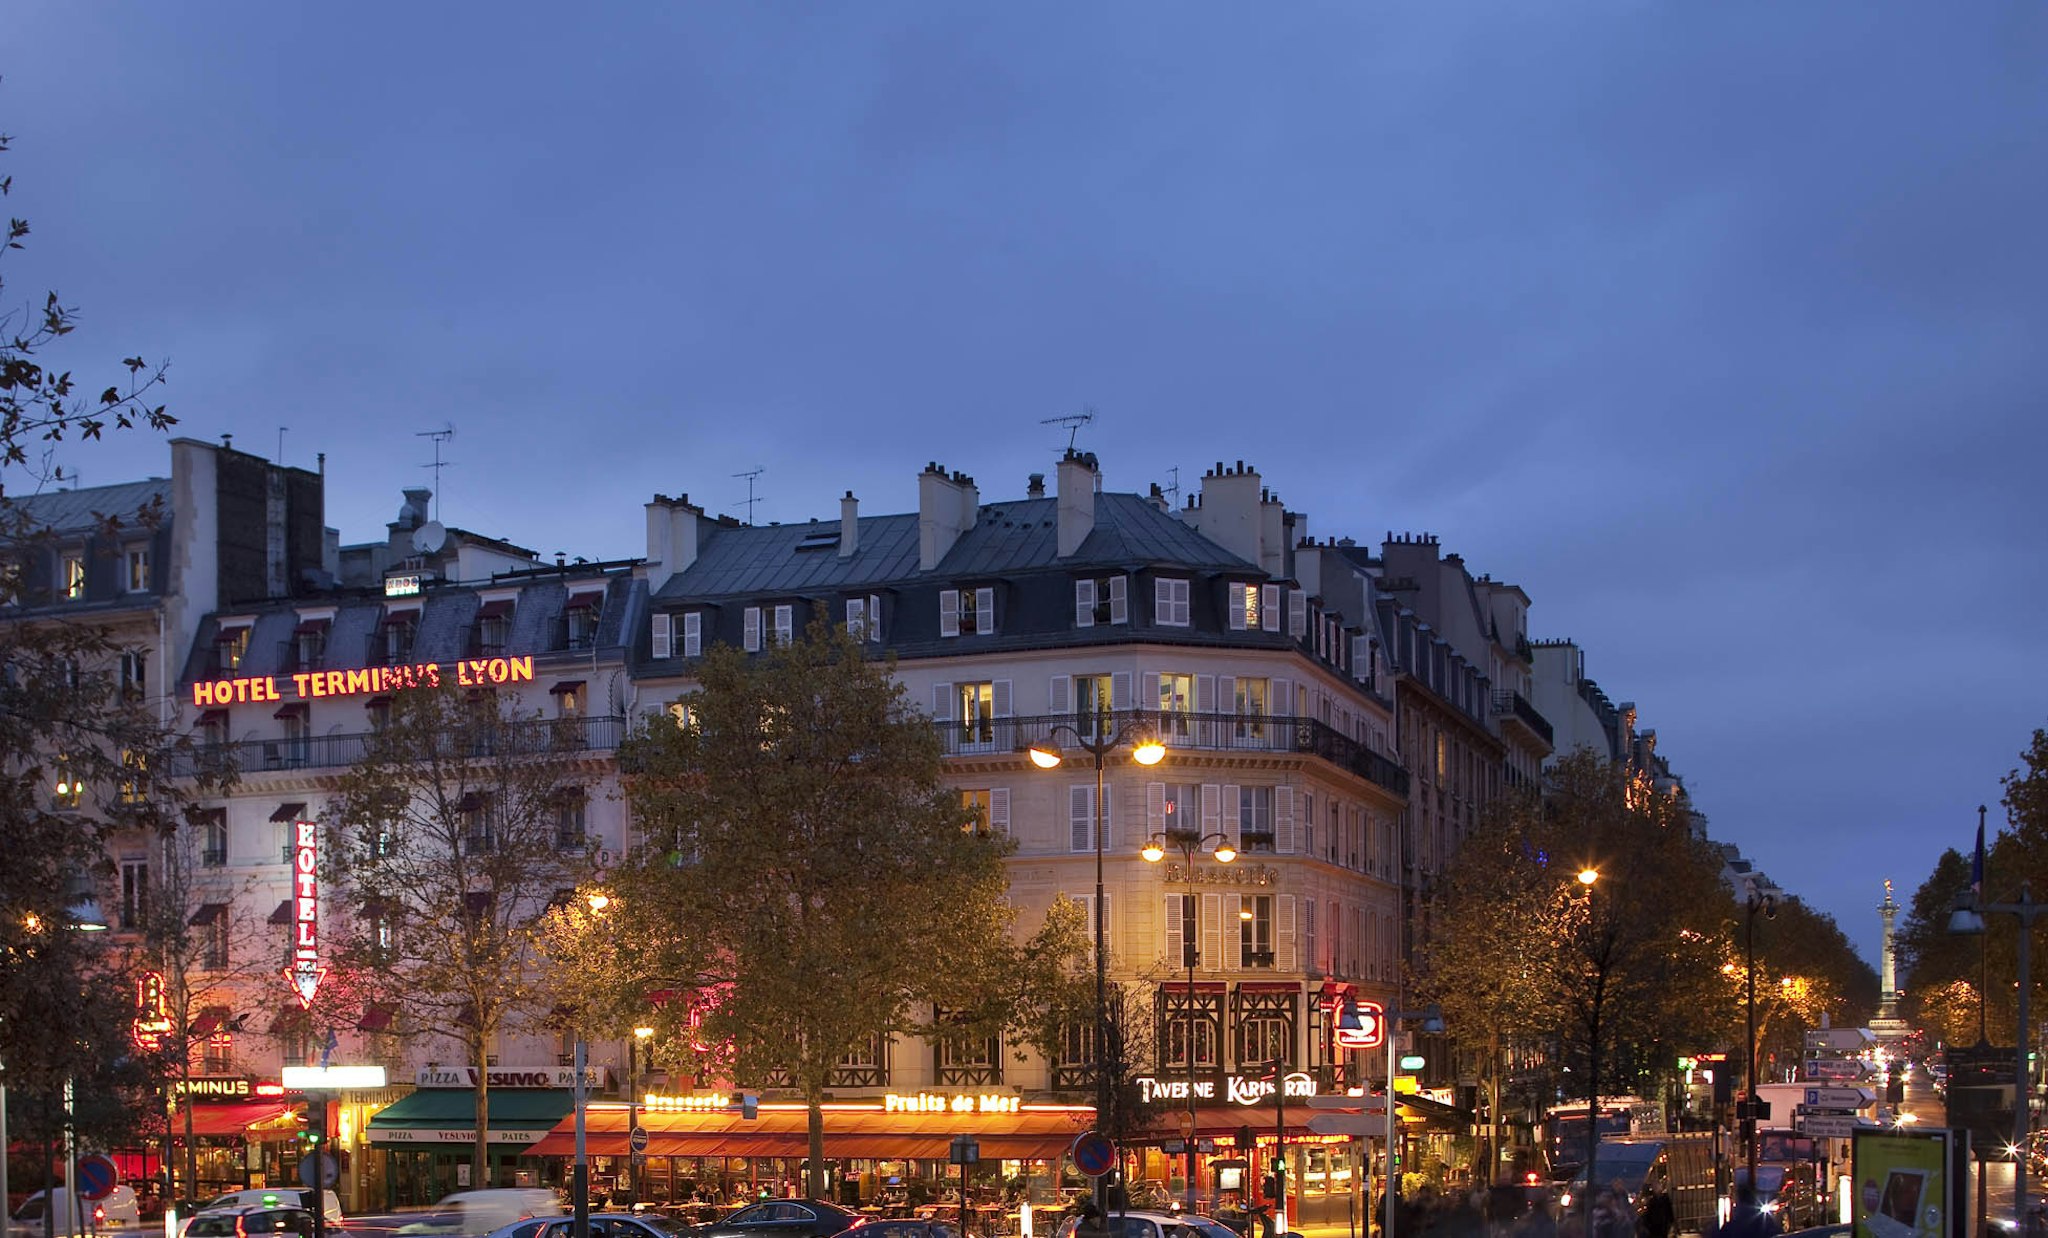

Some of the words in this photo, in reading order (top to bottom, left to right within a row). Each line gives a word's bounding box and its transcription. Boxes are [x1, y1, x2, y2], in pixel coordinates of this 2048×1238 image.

[193, 676, 281, 706] HOTEL
[292, 662, 440, 698] TERMINUS
[456, 655, 534, 686] LYON
[297, 823, 316, 946] HOTEL
[421, 1072, 460, 1084] PIZZA
[467, 1068, 549, 1086] VESUVIO
[885, 1092, 946, 1112] Fruits
[951, 1094, 975, 1112] de
[979, 1094, 1020, 1112] Mer
[388, 1131, 414, 1140] PIZZA
[438, 1131, 476, 1140] VESUVIO
[502, 1132, 530, 1141] PATES
